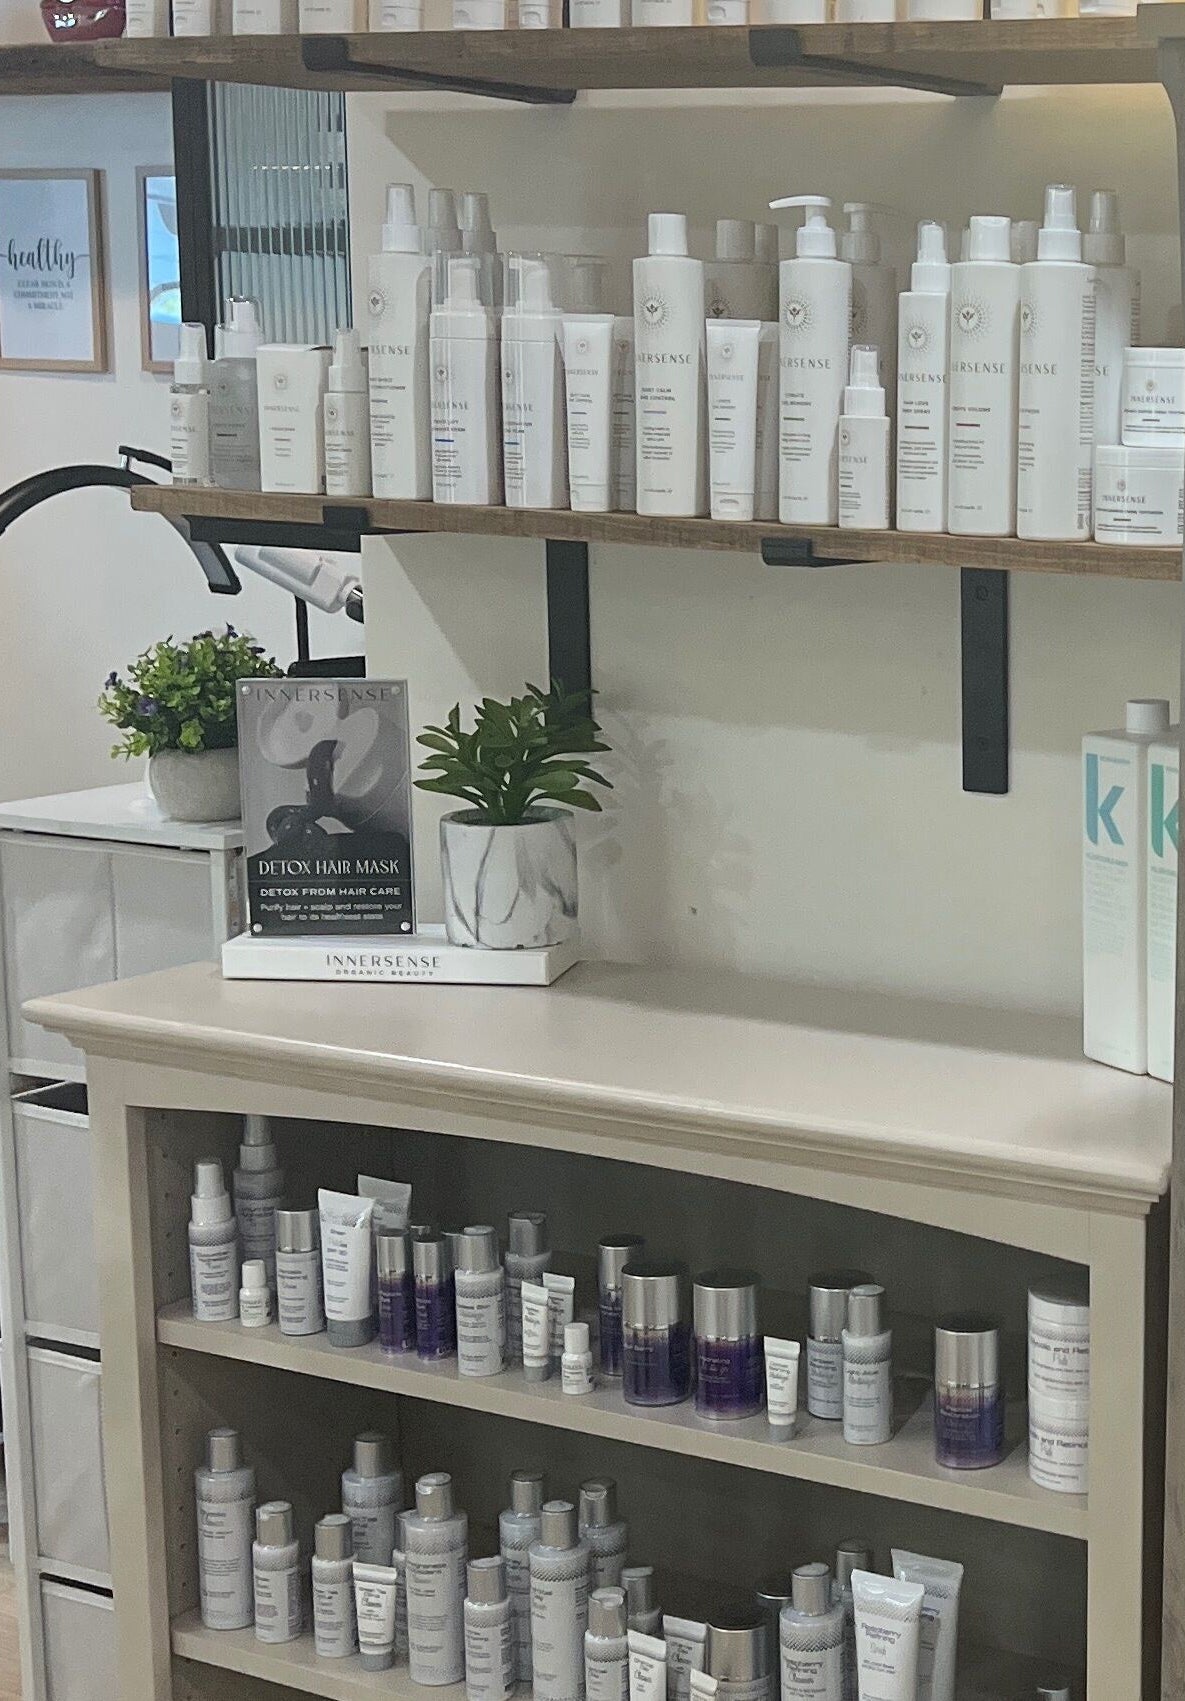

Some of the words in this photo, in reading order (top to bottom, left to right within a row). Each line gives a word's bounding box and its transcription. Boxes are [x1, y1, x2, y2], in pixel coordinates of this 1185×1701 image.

[8, 238, 77, 279] healthy
[256, 687, 390, 702] INNERSENSE
[259, 860, 311, 875] DETOX
[316, 860, 351, 875] HAIR
[355, 859, 400, 875] MASK
[260, 888, 299, 897] DETOX
[302, 888, 336, 896] FROM
[339, 888, 367, 896] HAIR
[369, 887, 401, 896] CARE
[326, 954, 442, 968] INNERSENSE
